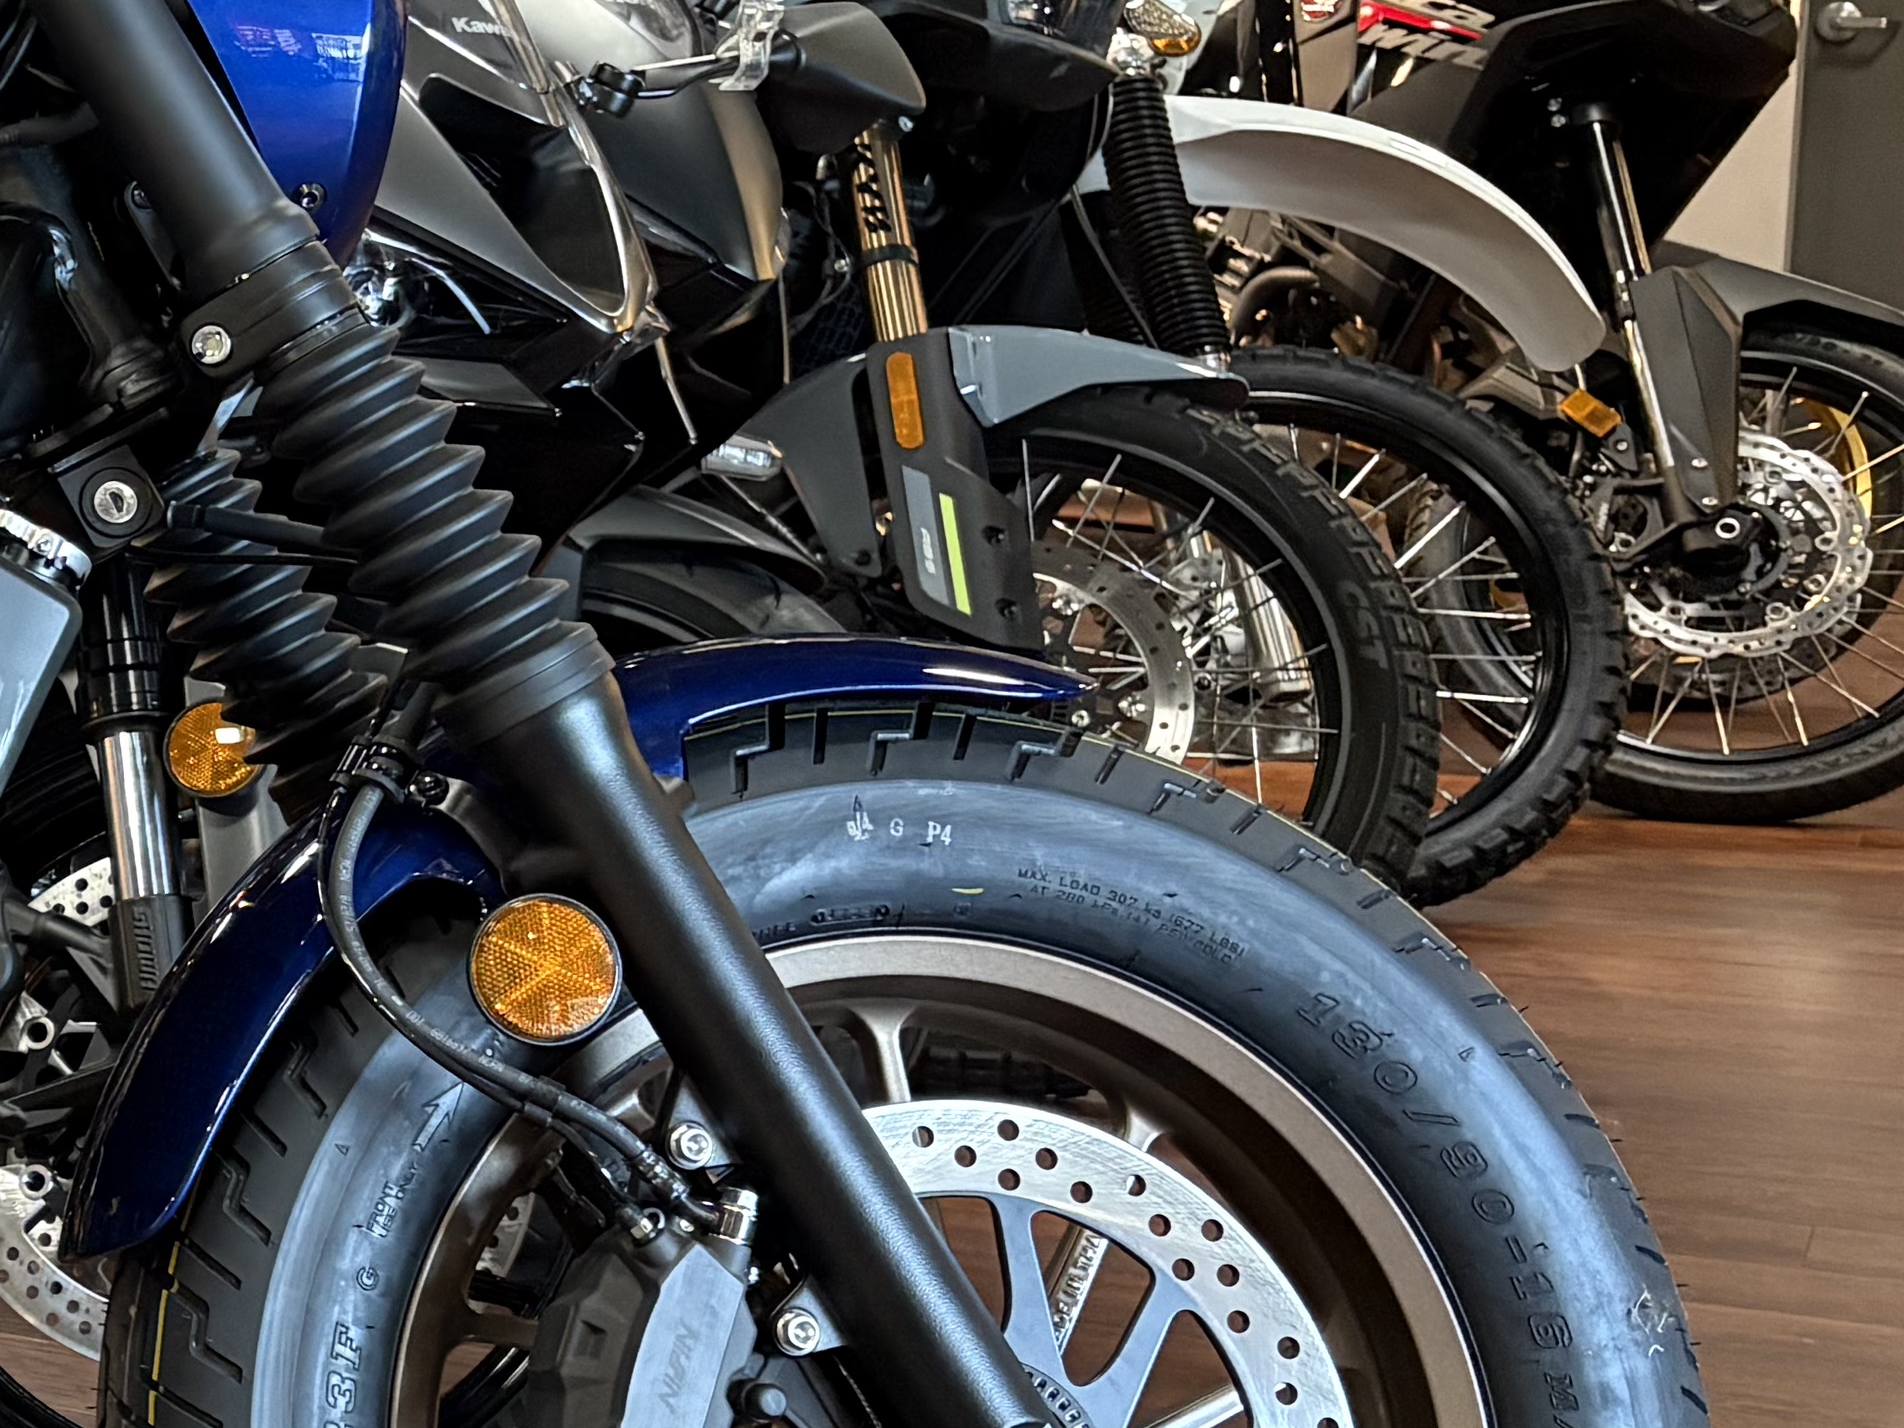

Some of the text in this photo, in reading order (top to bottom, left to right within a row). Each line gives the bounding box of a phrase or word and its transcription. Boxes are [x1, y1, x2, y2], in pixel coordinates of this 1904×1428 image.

[927, 821, 953, 845] P4
[1057, 875, 1102, 896] LOAD
[1105, 888, 1138, 909] 307
[1296, 992, 1573, 1350] 130/90-16
[363, 1180, 399, 1237] FRONT
